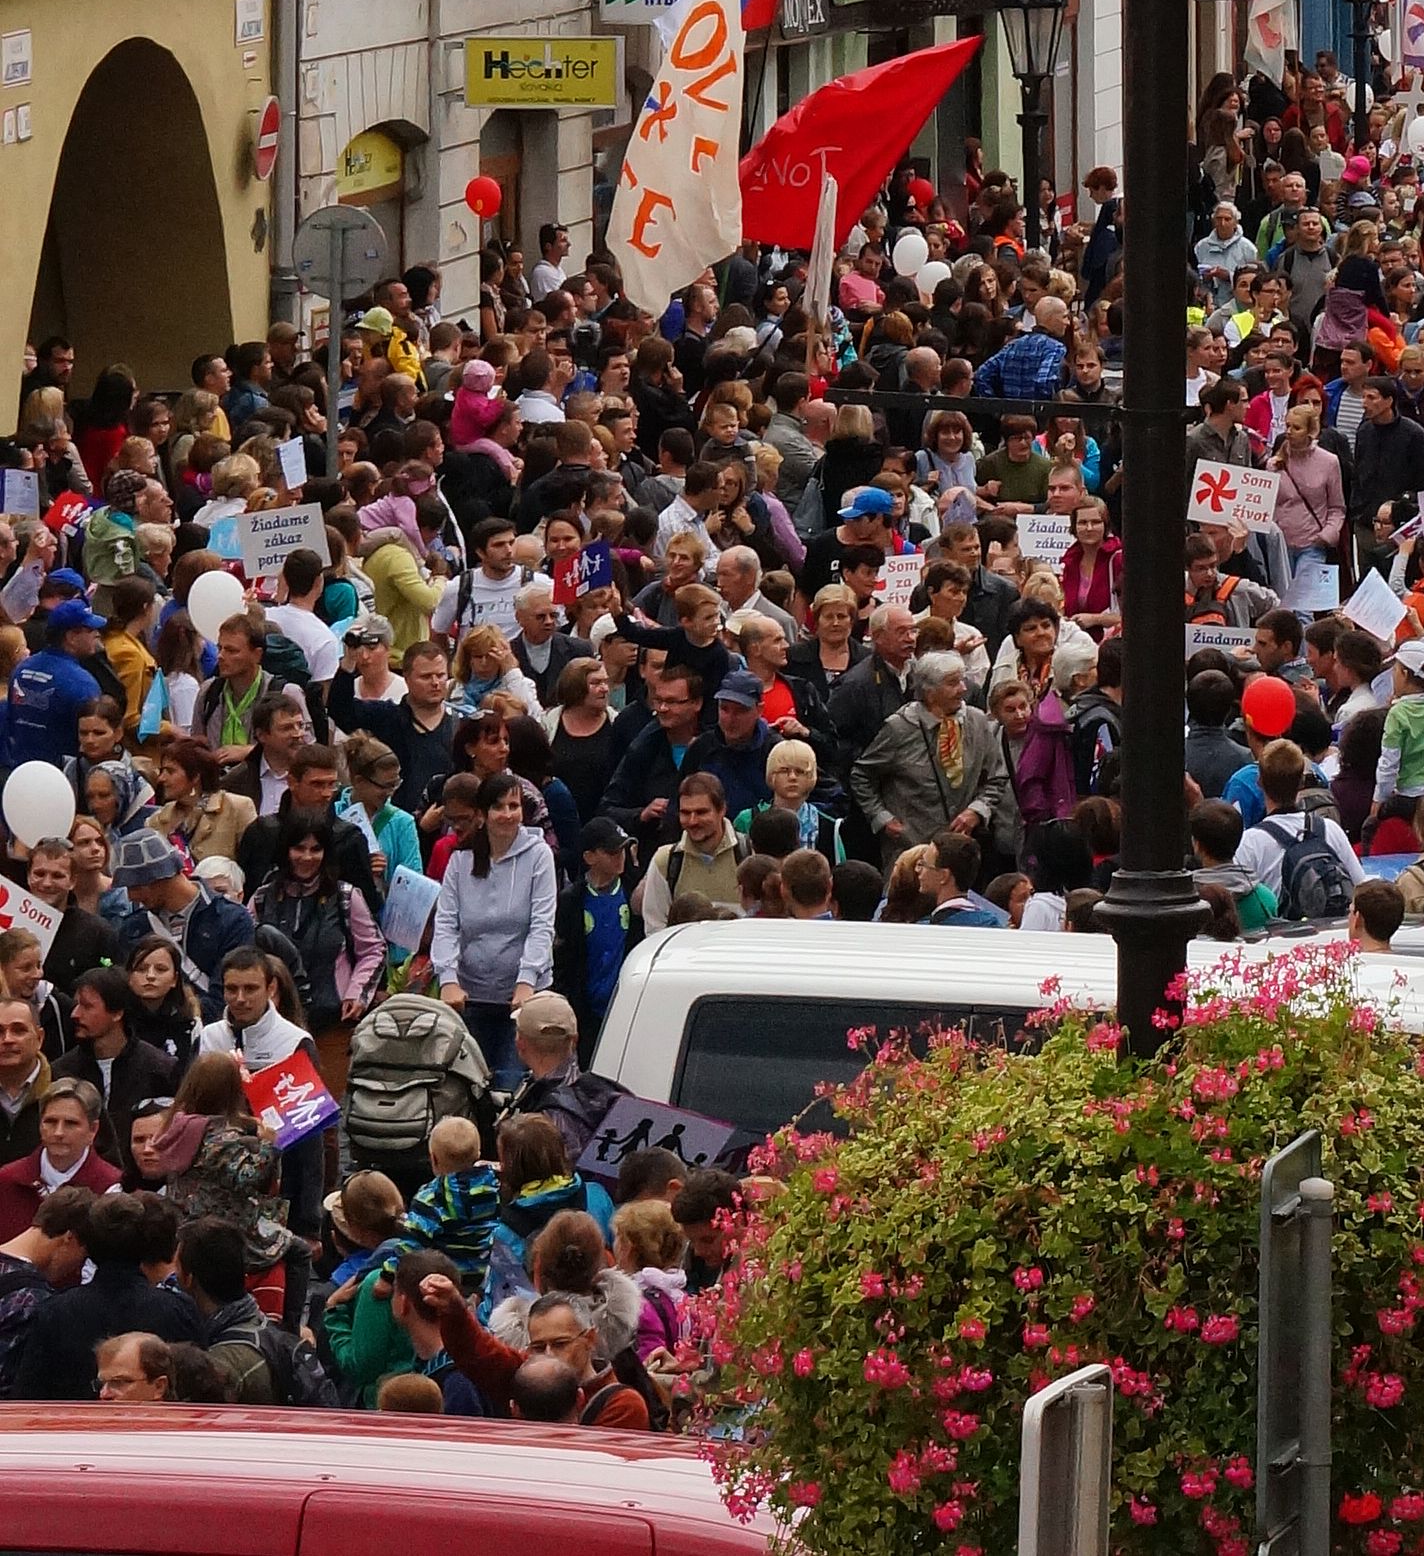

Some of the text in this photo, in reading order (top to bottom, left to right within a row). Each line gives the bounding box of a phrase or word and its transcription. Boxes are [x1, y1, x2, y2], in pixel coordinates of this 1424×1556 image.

[484, 41, 598, 80] Hechter
[1241, 472, 1273, 490] Som
[1245, 492, 1262, 505] za
[1232, 504, 1270, 523] život
[251, 514, 309, 533] Žiadame
[264, 533, 302, 548] zákaz
[888, 560, 920, 573] Som
[896, 579, 912, 589] za
[1193, 628, 1251, 647] Žiadame
[19, 899, 52, 929] Som
